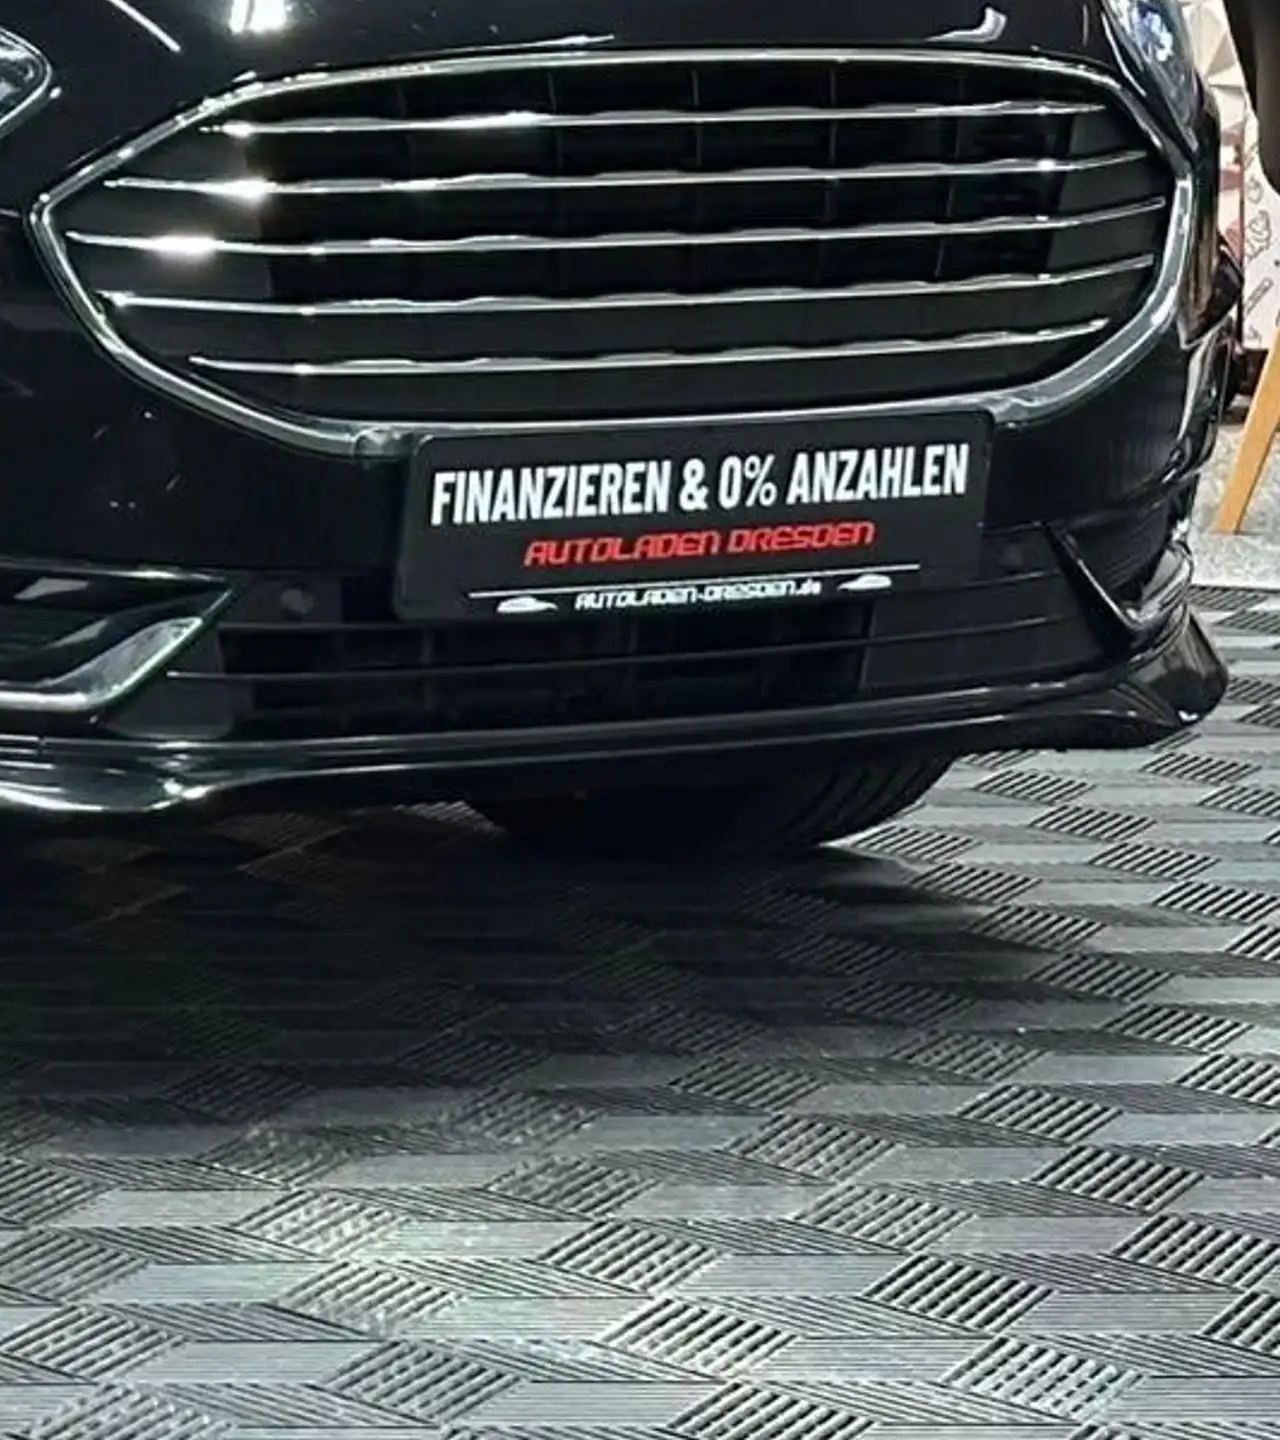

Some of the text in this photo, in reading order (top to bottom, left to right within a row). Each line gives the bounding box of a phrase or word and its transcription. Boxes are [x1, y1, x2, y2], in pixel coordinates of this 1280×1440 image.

[431, 443, 970, 526] FINANZIEREN & 0% ANZAHLEN
